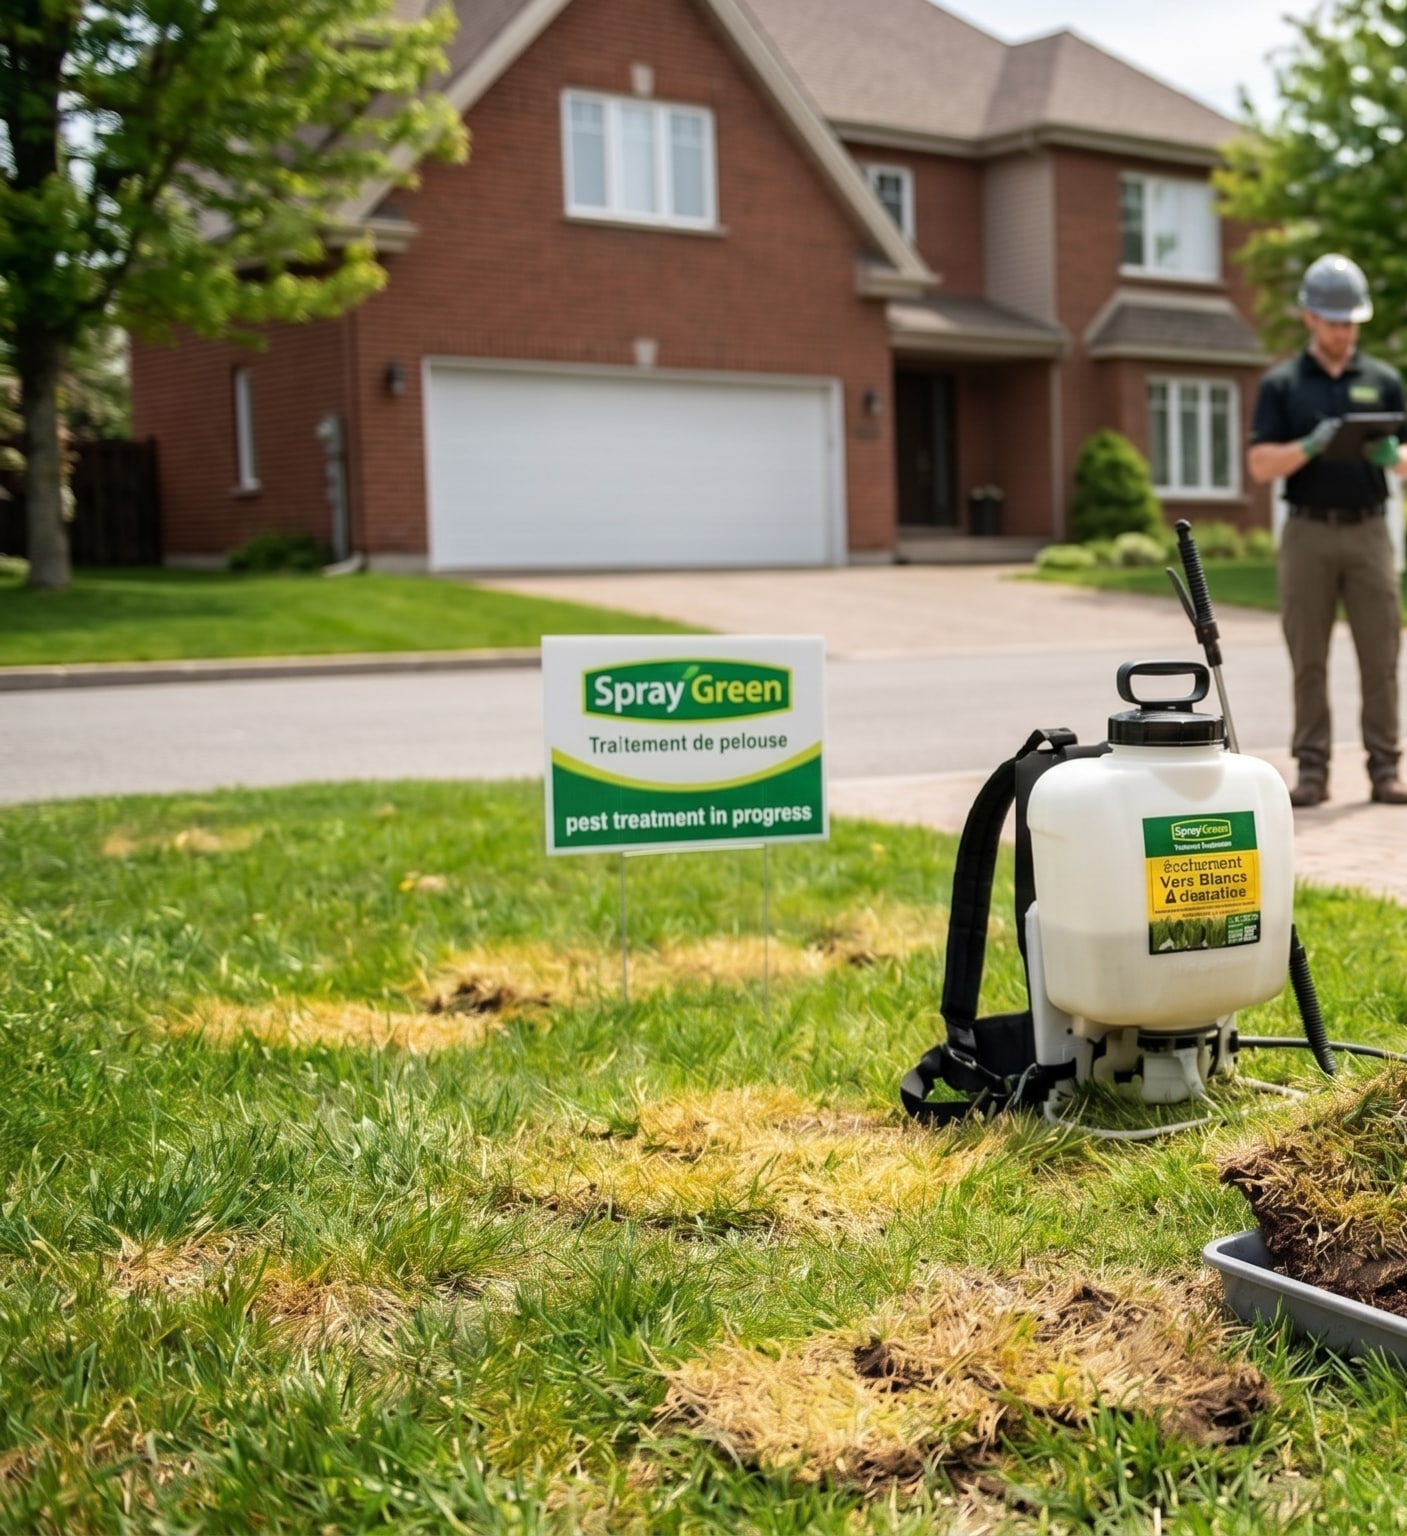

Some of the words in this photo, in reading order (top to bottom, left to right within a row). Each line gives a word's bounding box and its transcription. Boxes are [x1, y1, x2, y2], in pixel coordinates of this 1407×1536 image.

[594, 675, 685, 713] Spray
[691, 674, 782, 705] Green
[589, 735, 688, 754] Traitement
[693, 734, 714, 751] de
[720, 732, 788, 754] pelouse
[566, 811, 608, 836] pest
[613, 808, 706, 830] treatment
[710, 805, 728, 826] in
[732, 803, 812, 828] progress
[1159, 875, 1195, 889] Vers
[1199, 873, 1247, 886] Blancs
